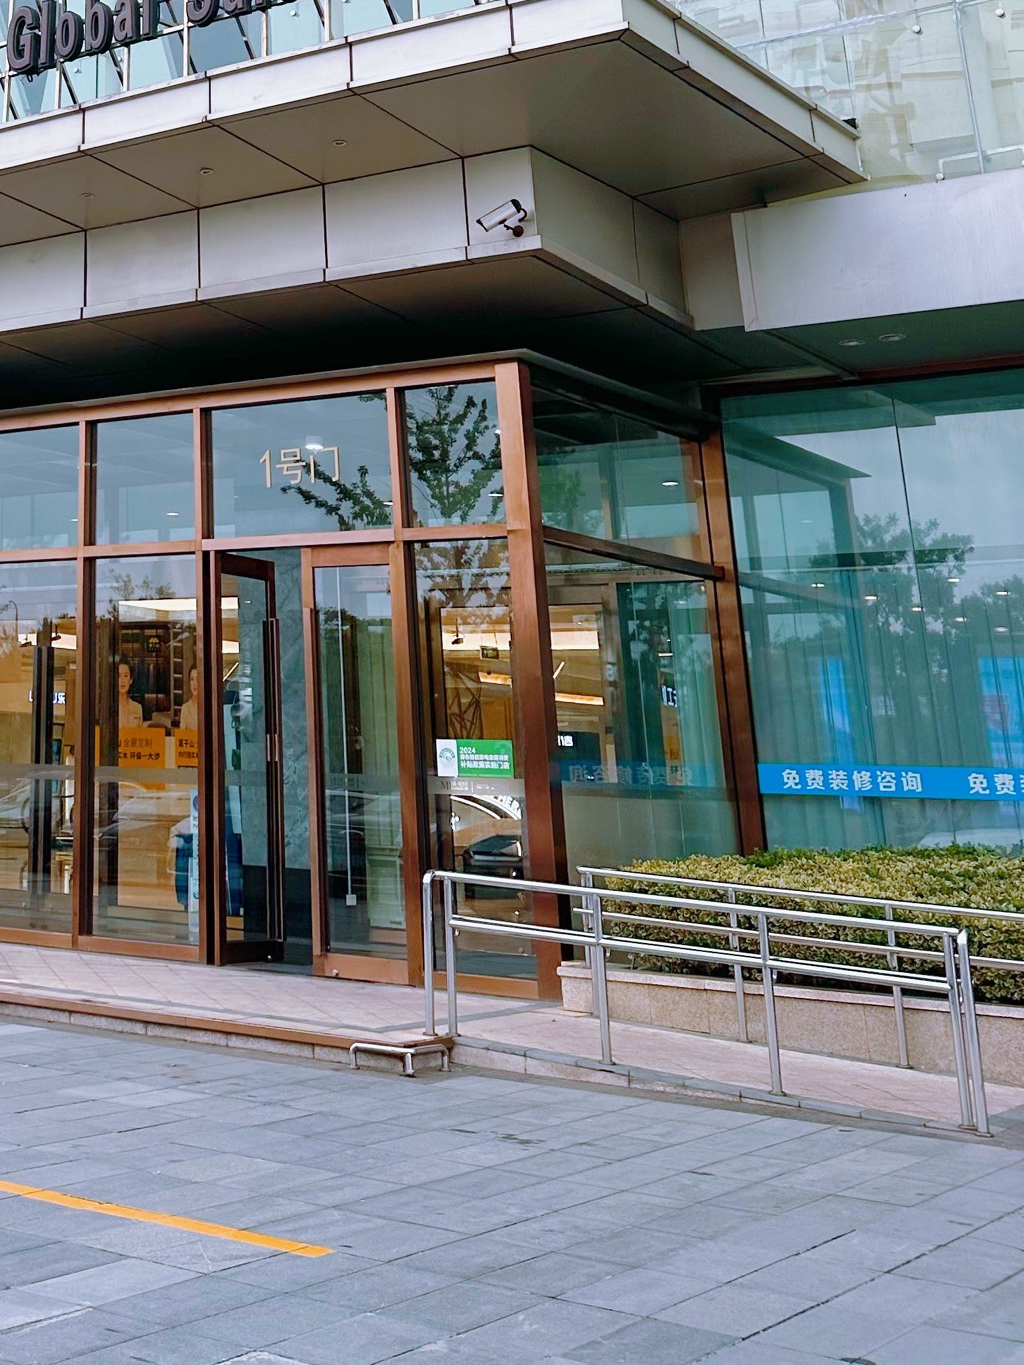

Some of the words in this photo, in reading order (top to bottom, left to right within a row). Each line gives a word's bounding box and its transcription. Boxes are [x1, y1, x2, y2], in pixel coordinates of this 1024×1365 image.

[259, 446, 339, 488] 1号门
[459, 746, 476, 754] 2024
[781, 768, 924, 793] 免费装修咨询
